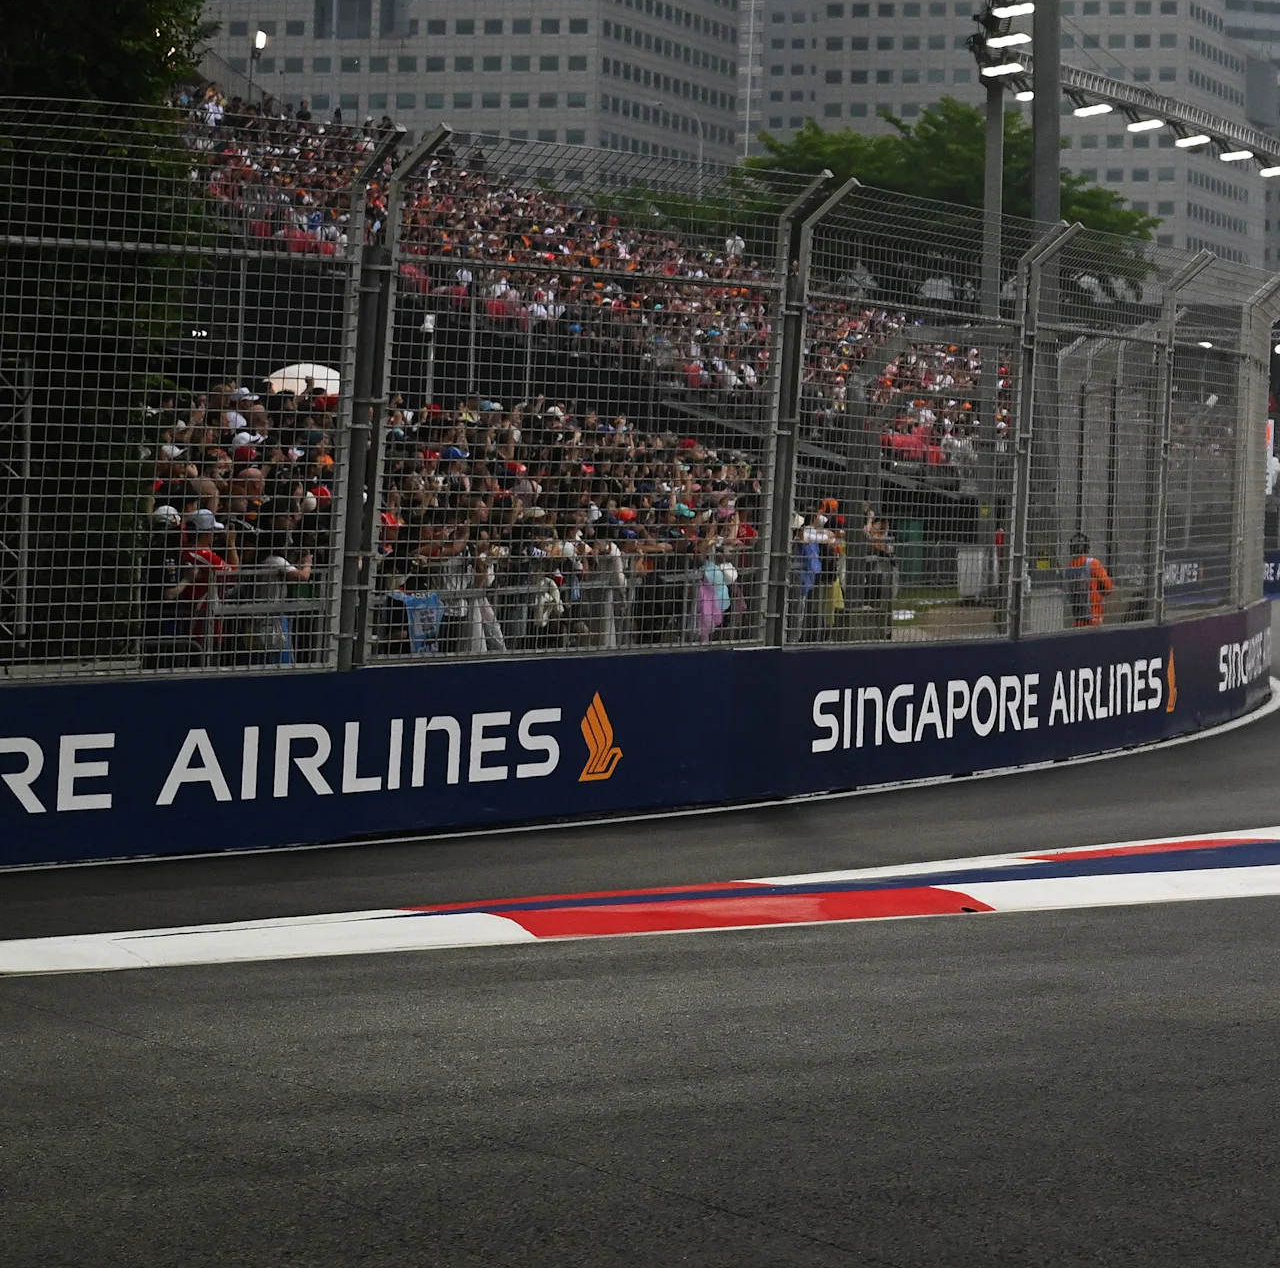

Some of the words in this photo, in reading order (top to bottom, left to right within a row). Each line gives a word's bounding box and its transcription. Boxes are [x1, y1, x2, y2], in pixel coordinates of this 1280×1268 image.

[812, 673, 1039, 753] SINGAPORE
[1048, 657, 1163, 726] AIRLINES
[0, 732, 116, 814] RE
[155, 707, 562, 806] AIRLINES
